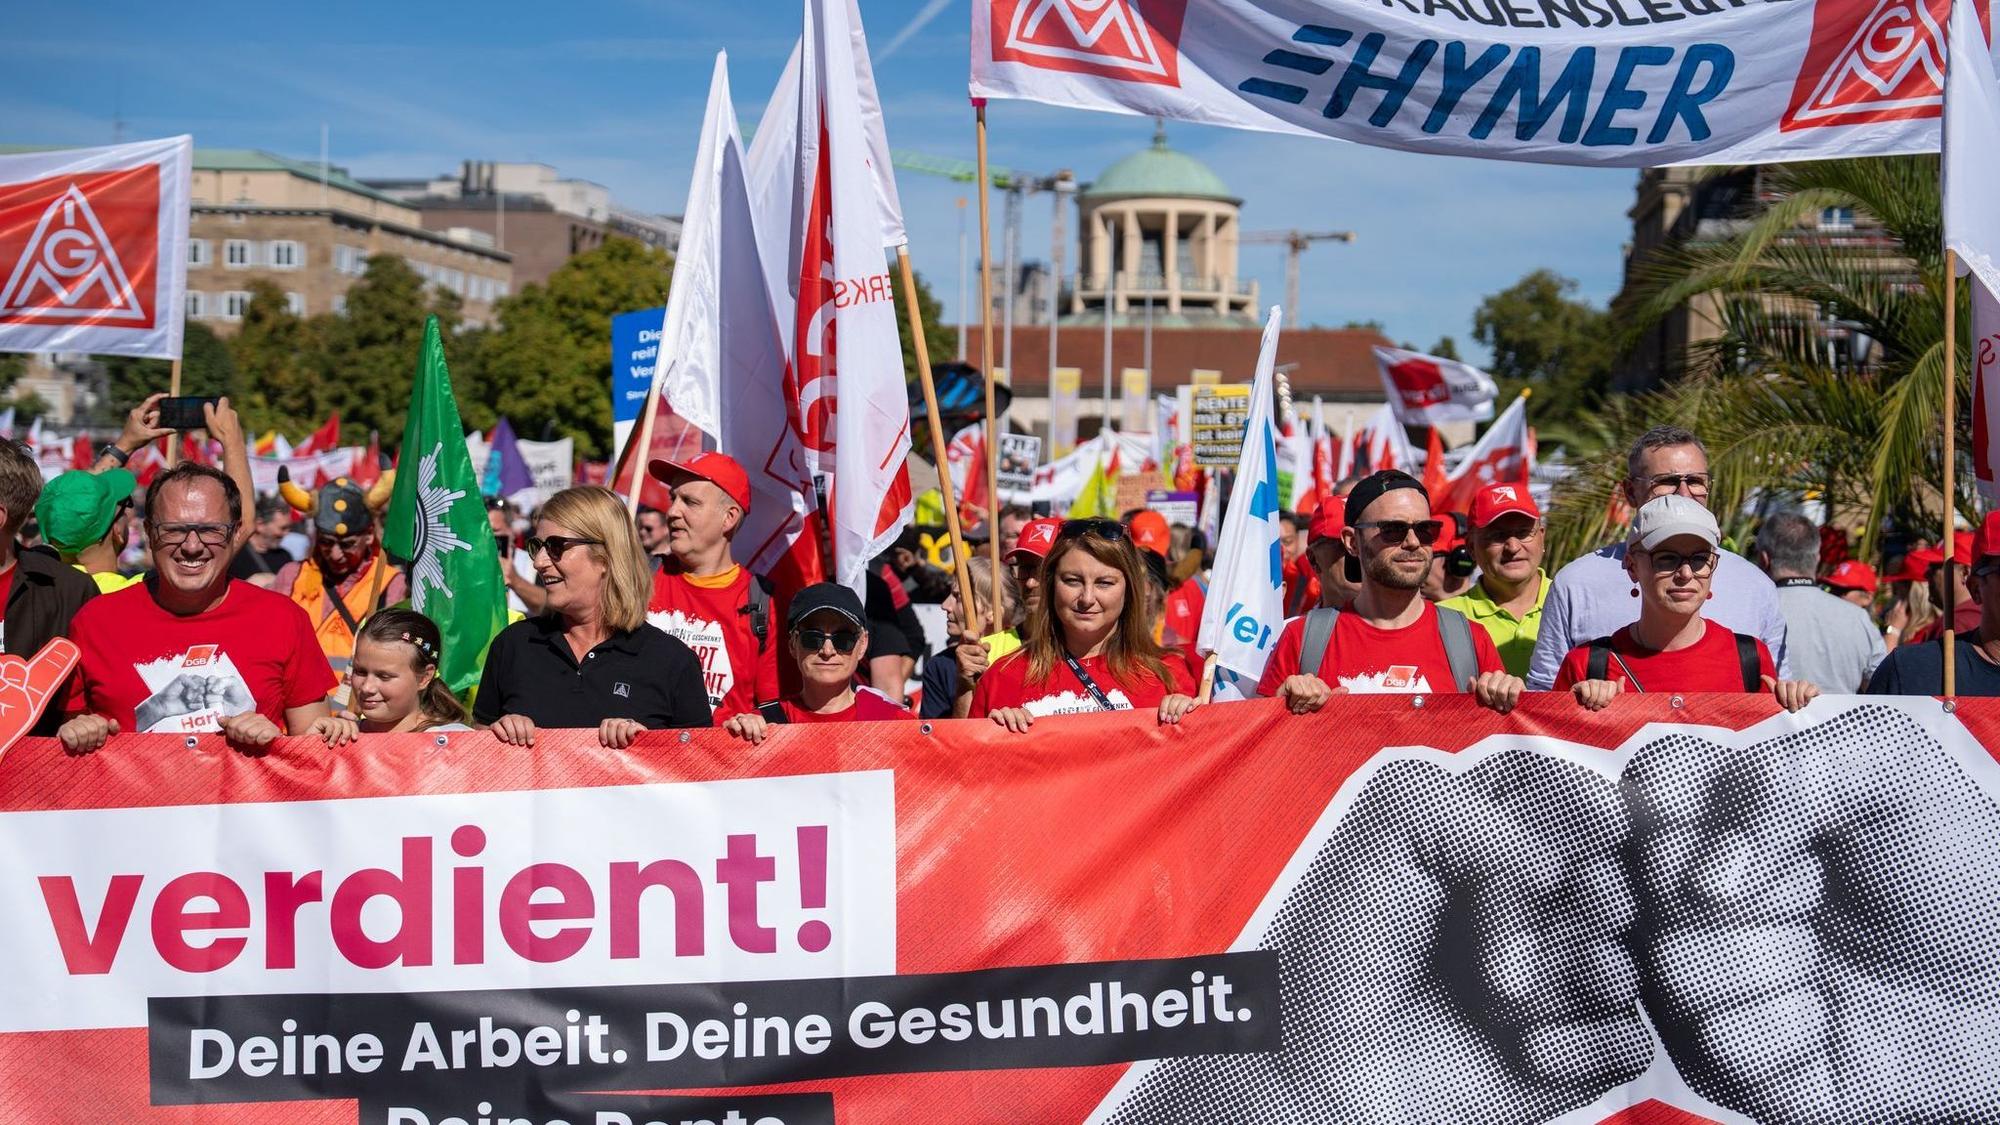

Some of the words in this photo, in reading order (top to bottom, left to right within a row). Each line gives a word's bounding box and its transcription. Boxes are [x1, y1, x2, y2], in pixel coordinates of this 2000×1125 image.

[185, 658, 207, 667] DGB
[37, 824, 832, 976] verdient!
[189, 1018, 384, 1080] Deine
[401, 1008, 628, 1071] Arbeit.
[646, 1001, 832, 1063] Deine
[848, 970, 1252, 1049] Gesundheit.
